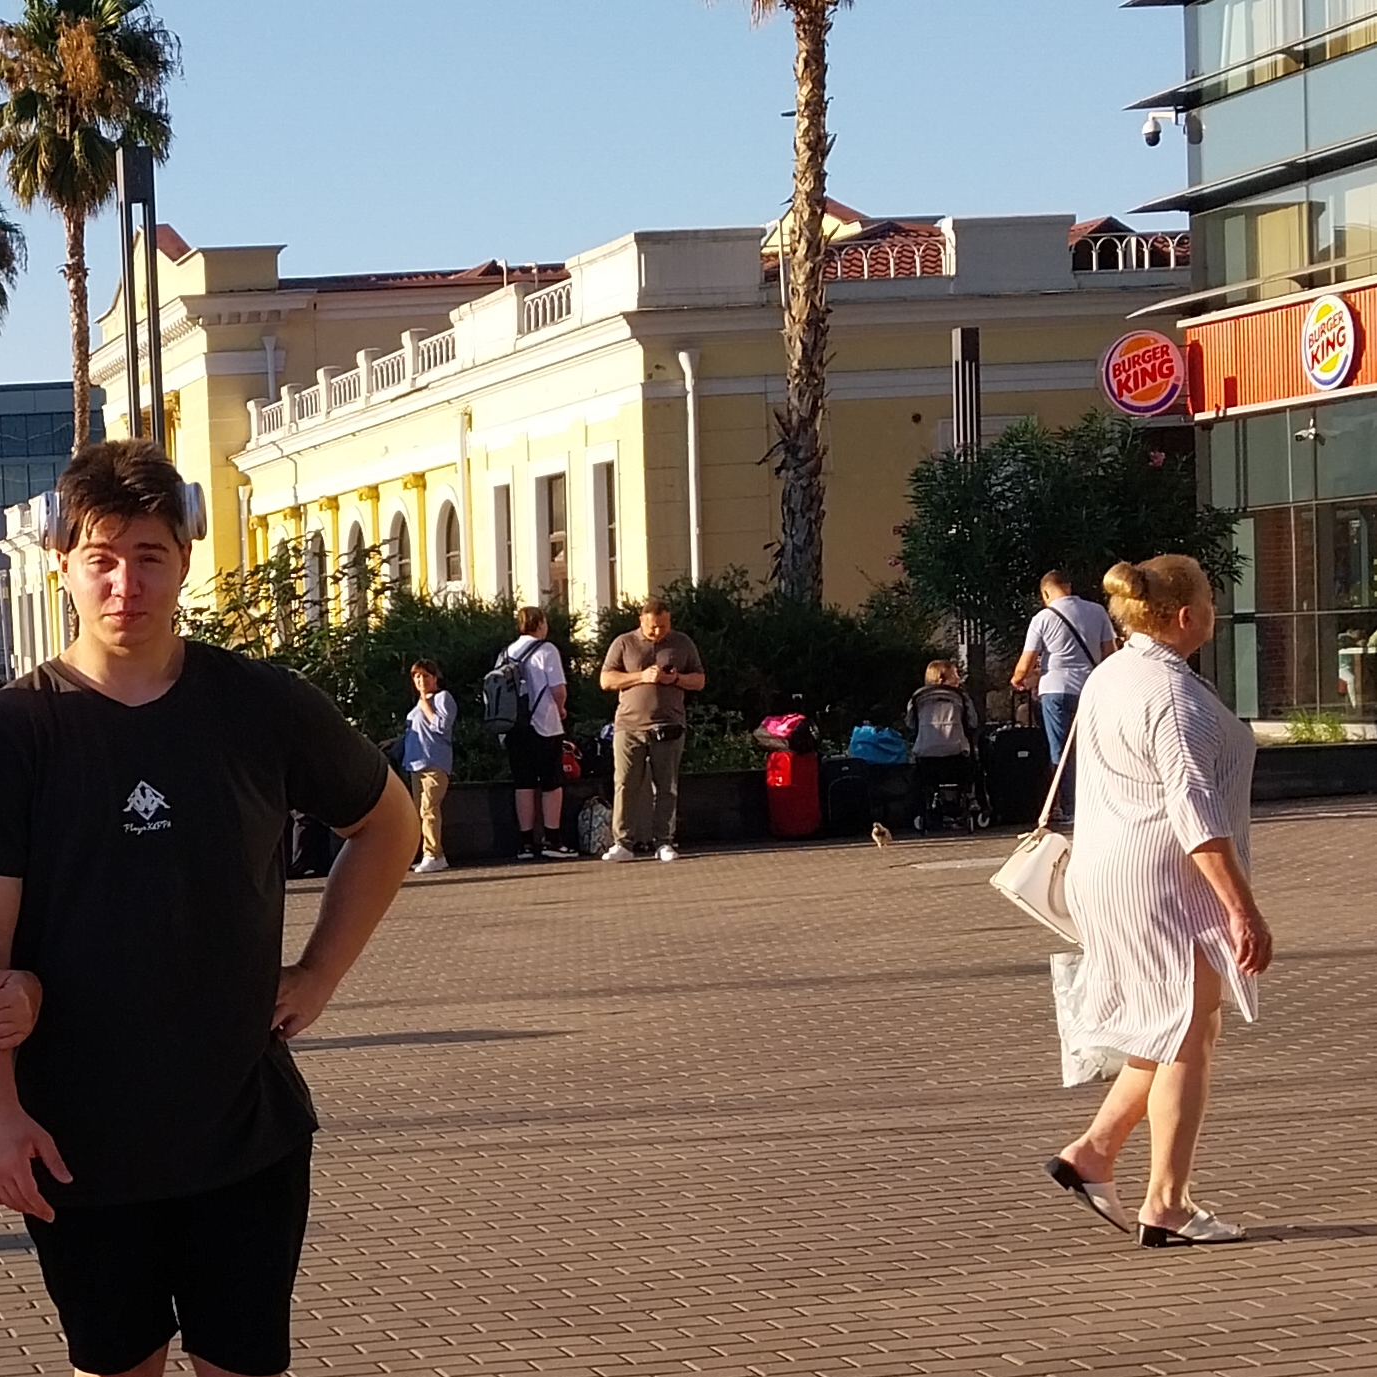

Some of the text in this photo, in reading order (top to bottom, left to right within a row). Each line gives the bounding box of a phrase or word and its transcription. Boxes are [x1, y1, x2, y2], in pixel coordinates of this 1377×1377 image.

[1309, 310, 1344, 349] BURGER
[1310, 326, 1346, 372] KING
[1112, 345, 1169, 379] BURGER
[1117, 358, 1174, 398] KING
